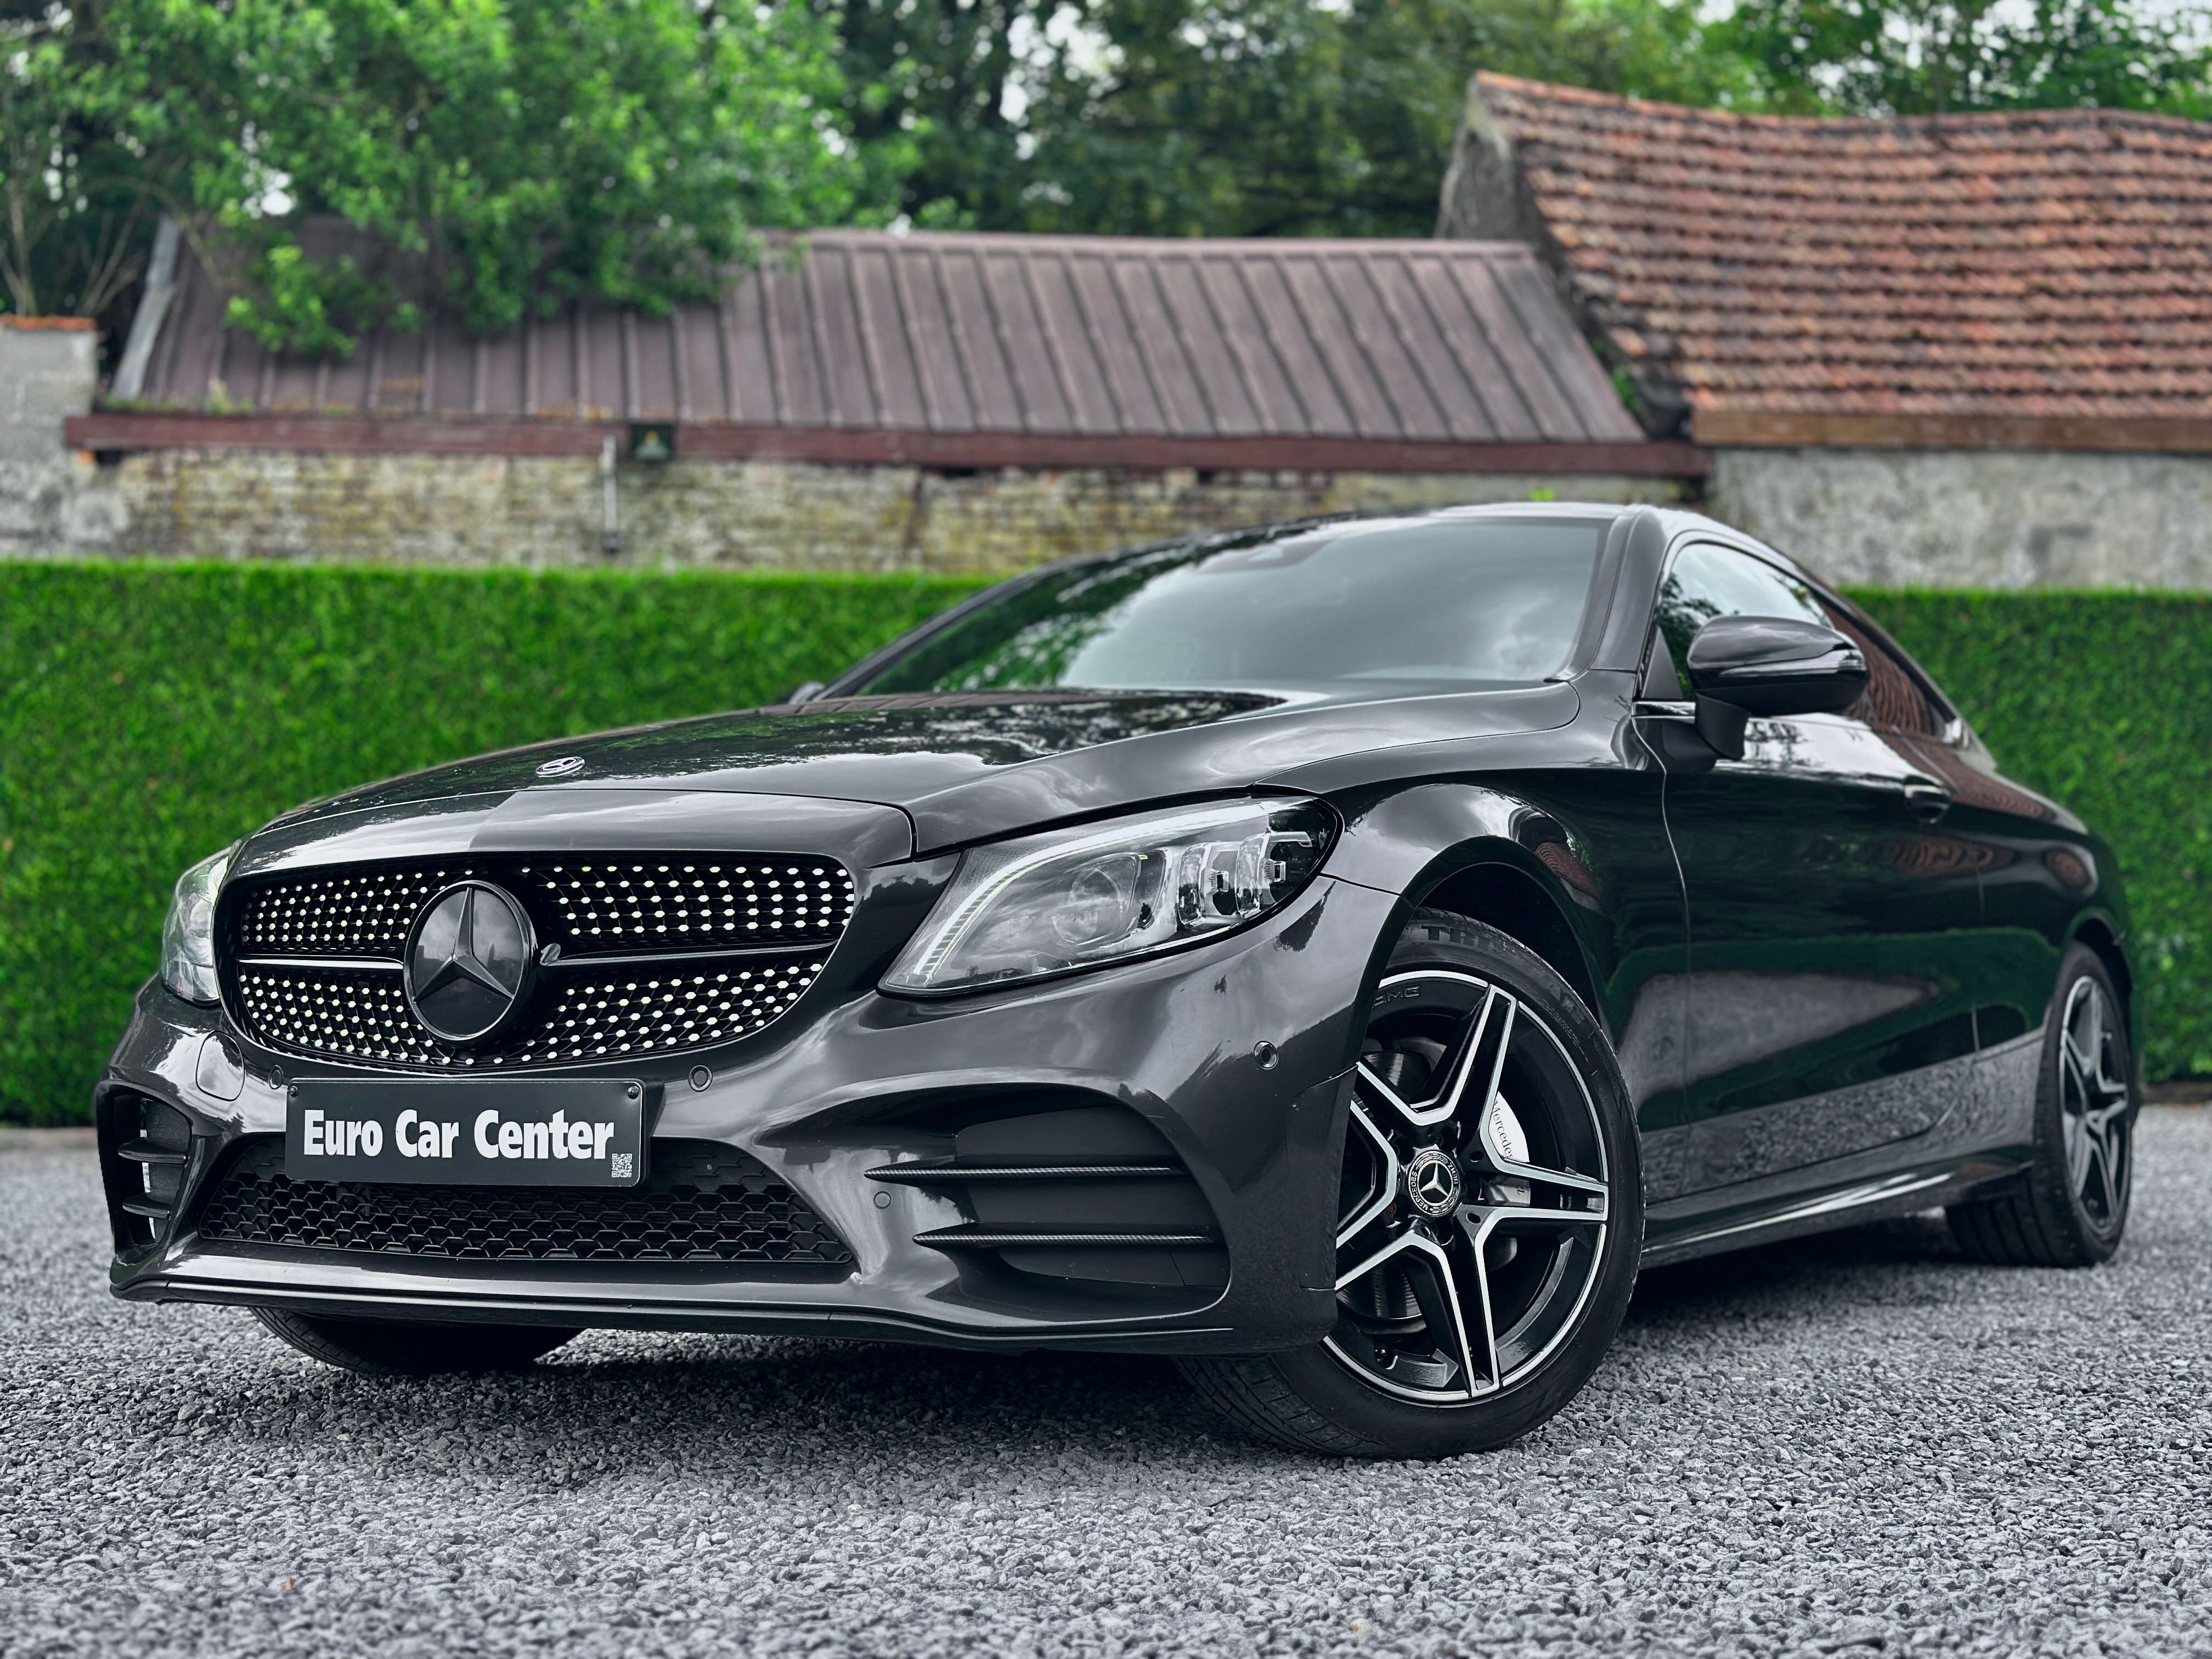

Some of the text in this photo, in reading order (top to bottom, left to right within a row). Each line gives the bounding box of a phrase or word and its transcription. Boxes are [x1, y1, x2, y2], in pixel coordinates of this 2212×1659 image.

[1372, 986, 1420, 1009] AMG
[304, 1109, 614, 1159] Euro Car Center
[1411, 1171, 1429, 1210] MERCEDES
